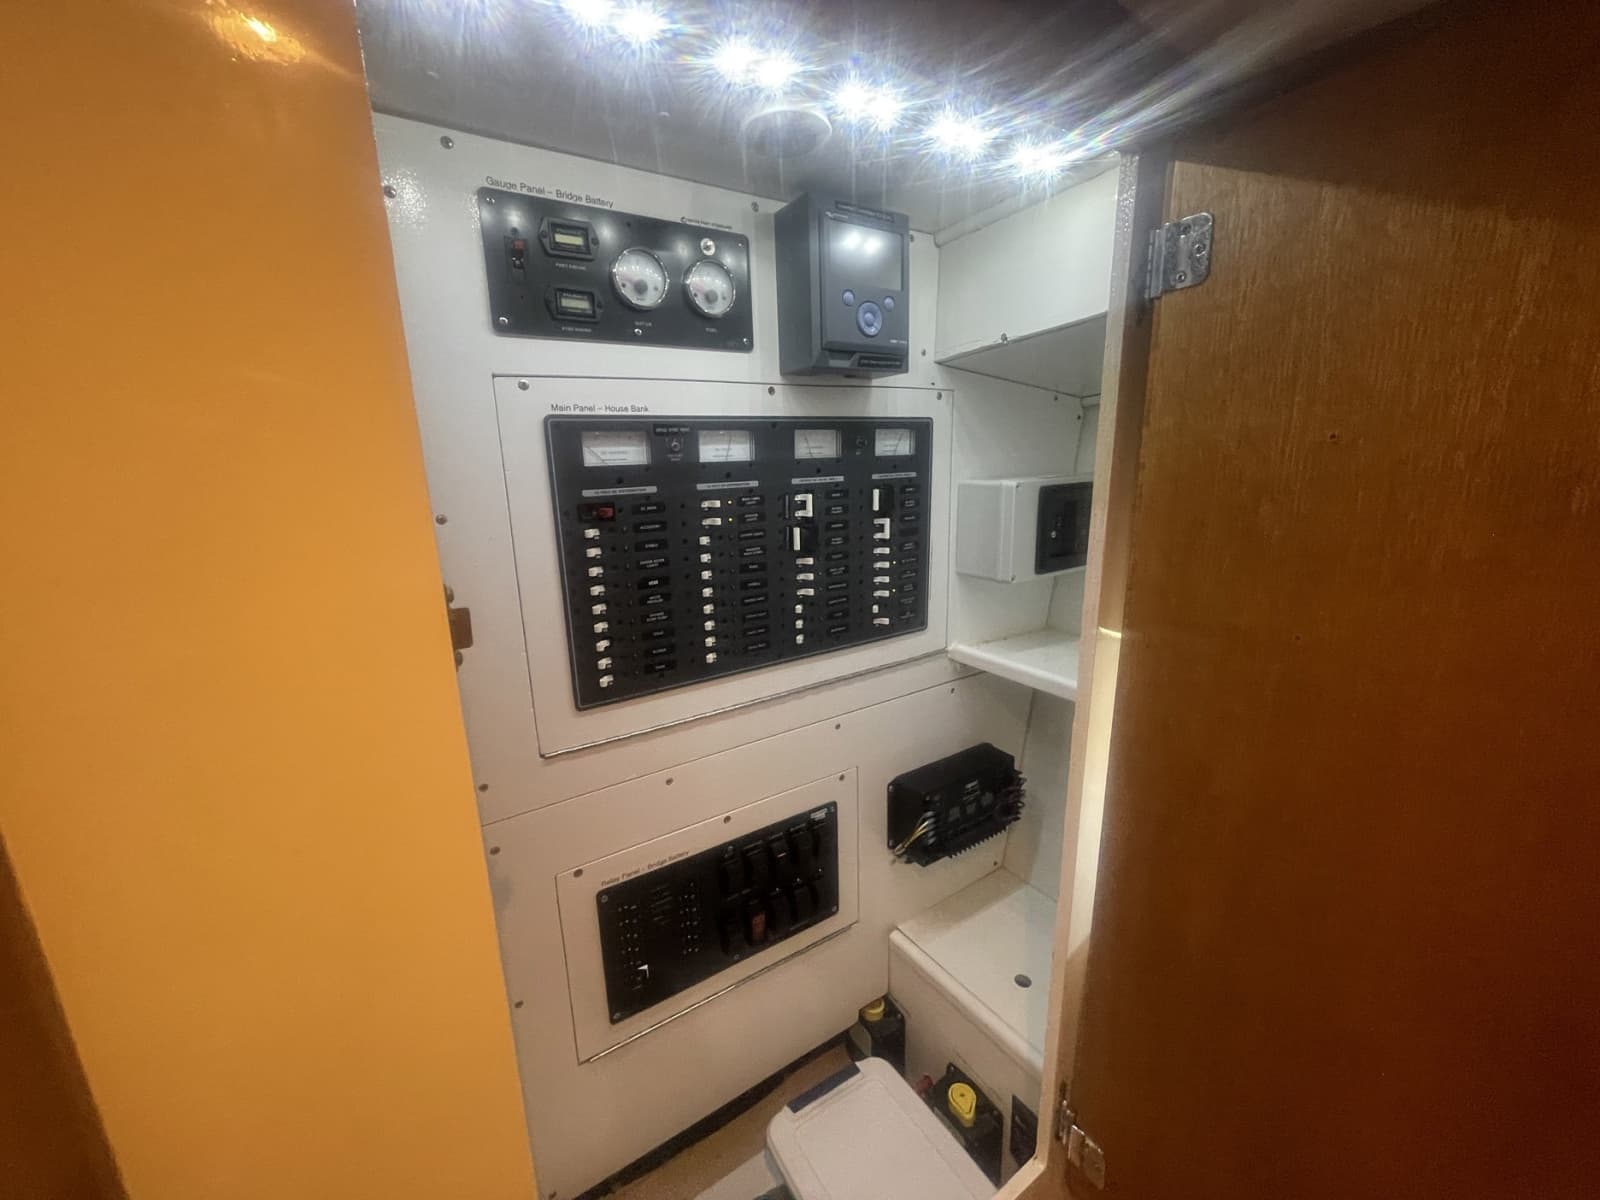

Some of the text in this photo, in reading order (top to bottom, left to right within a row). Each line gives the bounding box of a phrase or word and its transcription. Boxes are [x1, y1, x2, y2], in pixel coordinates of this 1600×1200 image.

[485, 176, 517, 191] Gauge
[520, 182, 546, 195] Panel
[555, 189, 583, 203] Bridge
[585, 195, 614, 209] Battery
[551, 403, 572, 412] Main
[573, 404, 596, 412] Panel
[604, 404, 629, 413] House
[630, 404, 649, 413] Bank
[622, 870, 641, 880] Panel
[647, 859, 668, 871] Bridge
